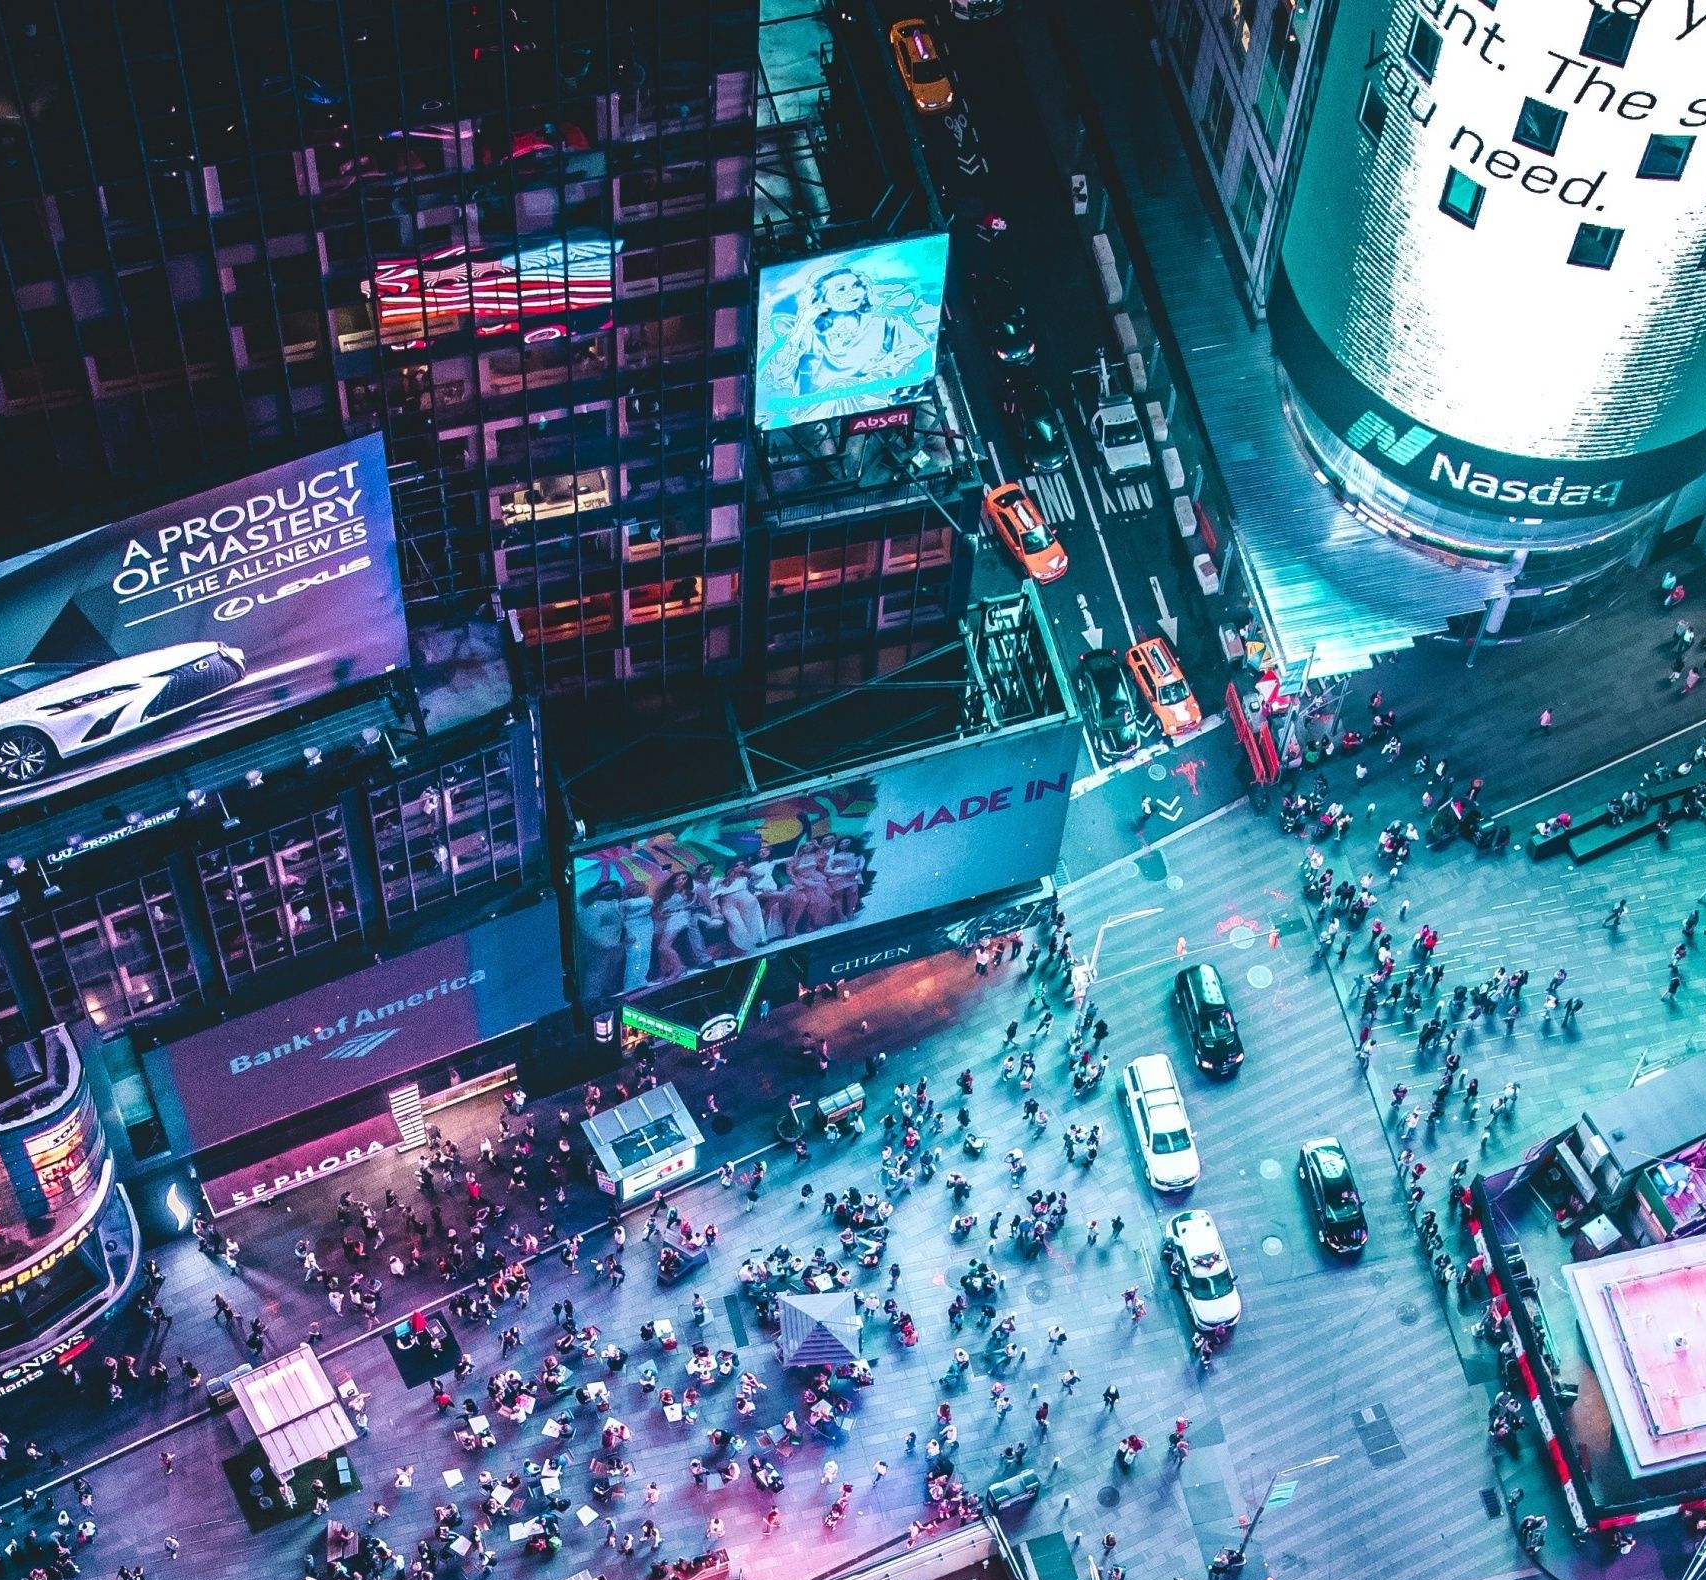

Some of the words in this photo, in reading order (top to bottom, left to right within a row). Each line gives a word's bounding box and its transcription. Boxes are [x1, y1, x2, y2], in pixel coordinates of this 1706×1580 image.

[1417, 0, 1507, 71] ant.
[1544, 50, 1657, 121] The
[1363, 30, 1437, 128] you
[1450, 125, 1608, 211] need.
[853, 412, 909, 431] Absen
[122, 539, 152, 567] A
[158, 461, 359, 553] PRODUCT
[1429, 451, 1625, 508] Nasdaq
[112, 558, 170, 596] OF
[179, 489, 362, 575] MASTERY
[172, 575, 221, 602] THE
[226, 534, 332, 585] ALL-NEW
[339, 523, 367, 546] ES
[257, 555, 372, 605] LEXUS
[885, 786, 1014, 841] MADE
[1024, 772, 1068, 803] IN
[830, 945, 911, 974] CITIZEN
[229, 1033, 312, 1076] Bank
[316, 1016, 350, 1042] of
[354, 969, 486, 1029] America
[232, 1140, 385, 1206] SEPHORA
[20, 1331, 86, 1373] NEWS
